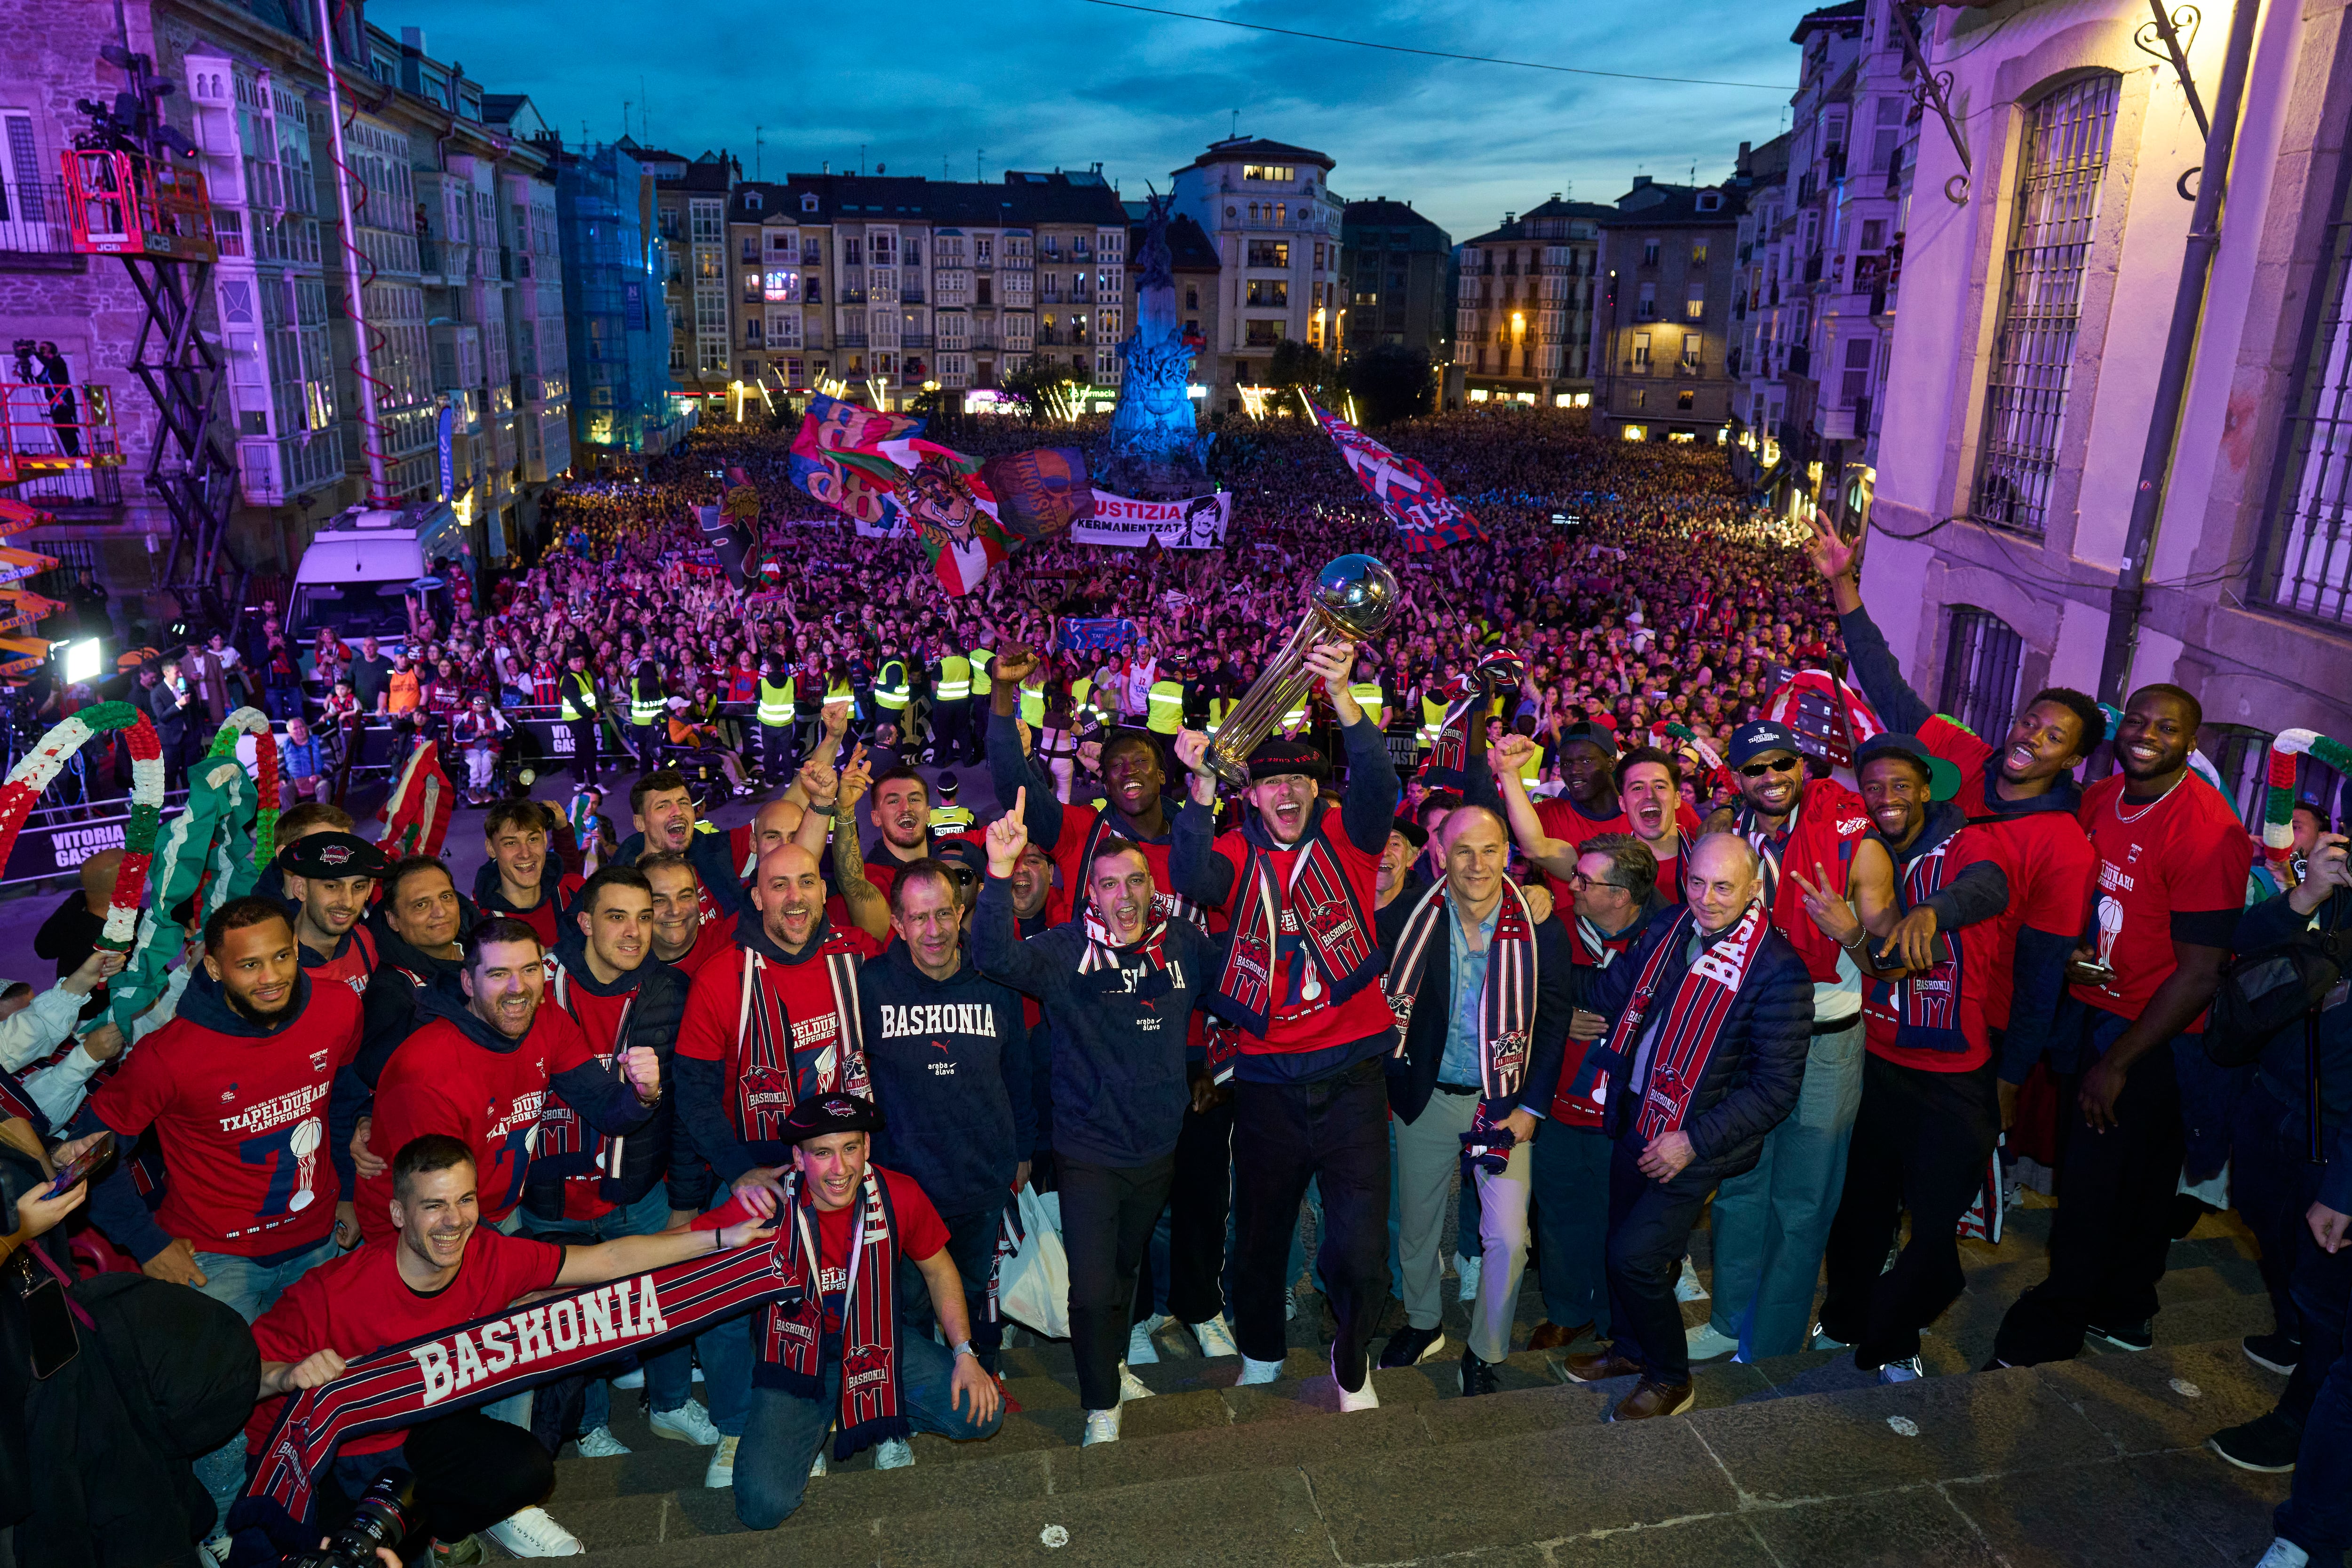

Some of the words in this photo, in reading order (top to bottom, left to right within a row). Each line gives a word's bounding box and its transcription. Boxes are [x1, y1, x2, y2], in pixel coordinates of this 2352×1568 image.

[145, 233, 171, 253] JCB
[1095, 500, 1181, 520] USTIZIA
[1077, 518, 1182, 533] KERMANENTZAT
[1442, 728, 1463, 742] SKONIA
[51, 824, 126, 850] VITORIA
[2097, 875, 2117, 892] PEONES
[2100, 863, 2134, 892] LDUNAK!
[1321, 919, 1354, 948] BASKONIA
[1236, 955, 1268, 982] BASKONIA
[1915, 979, 1950, 992] BASKONIA
[809, 1014, 827, 1023] VALENCIA
[881, 1004, 996, 1039] BASKONIA
[793, 1029, 835, 1049] AMPEONES
[928, 1061, 948, 1070] araba
[220, 1080, 330, 1132] TXAPELDUNAK!
[244, 1105, 257, 1113] COPA
[278, 1090, 301, 1101] VALENCIA
[512, 1093, 530, 1103] ALENCIA
[749, 1091, 788, 1107] BASKONIA
[1649, 1089, 1678, 1115] BASKONIA
[250, 1104, 311, 1133] CAMPEONES
[511, 1107, 542, 1124] EONES
[541, 1108, 572, 1121] SKONIA
[410, 1274, 668, 1407] BASKONIA
[776, 1319, 812, 1341] BASKONIA
[848, 1368, 886, 1390] BASKONIA
[279, 1441, 308, 1489] BASKONIA
